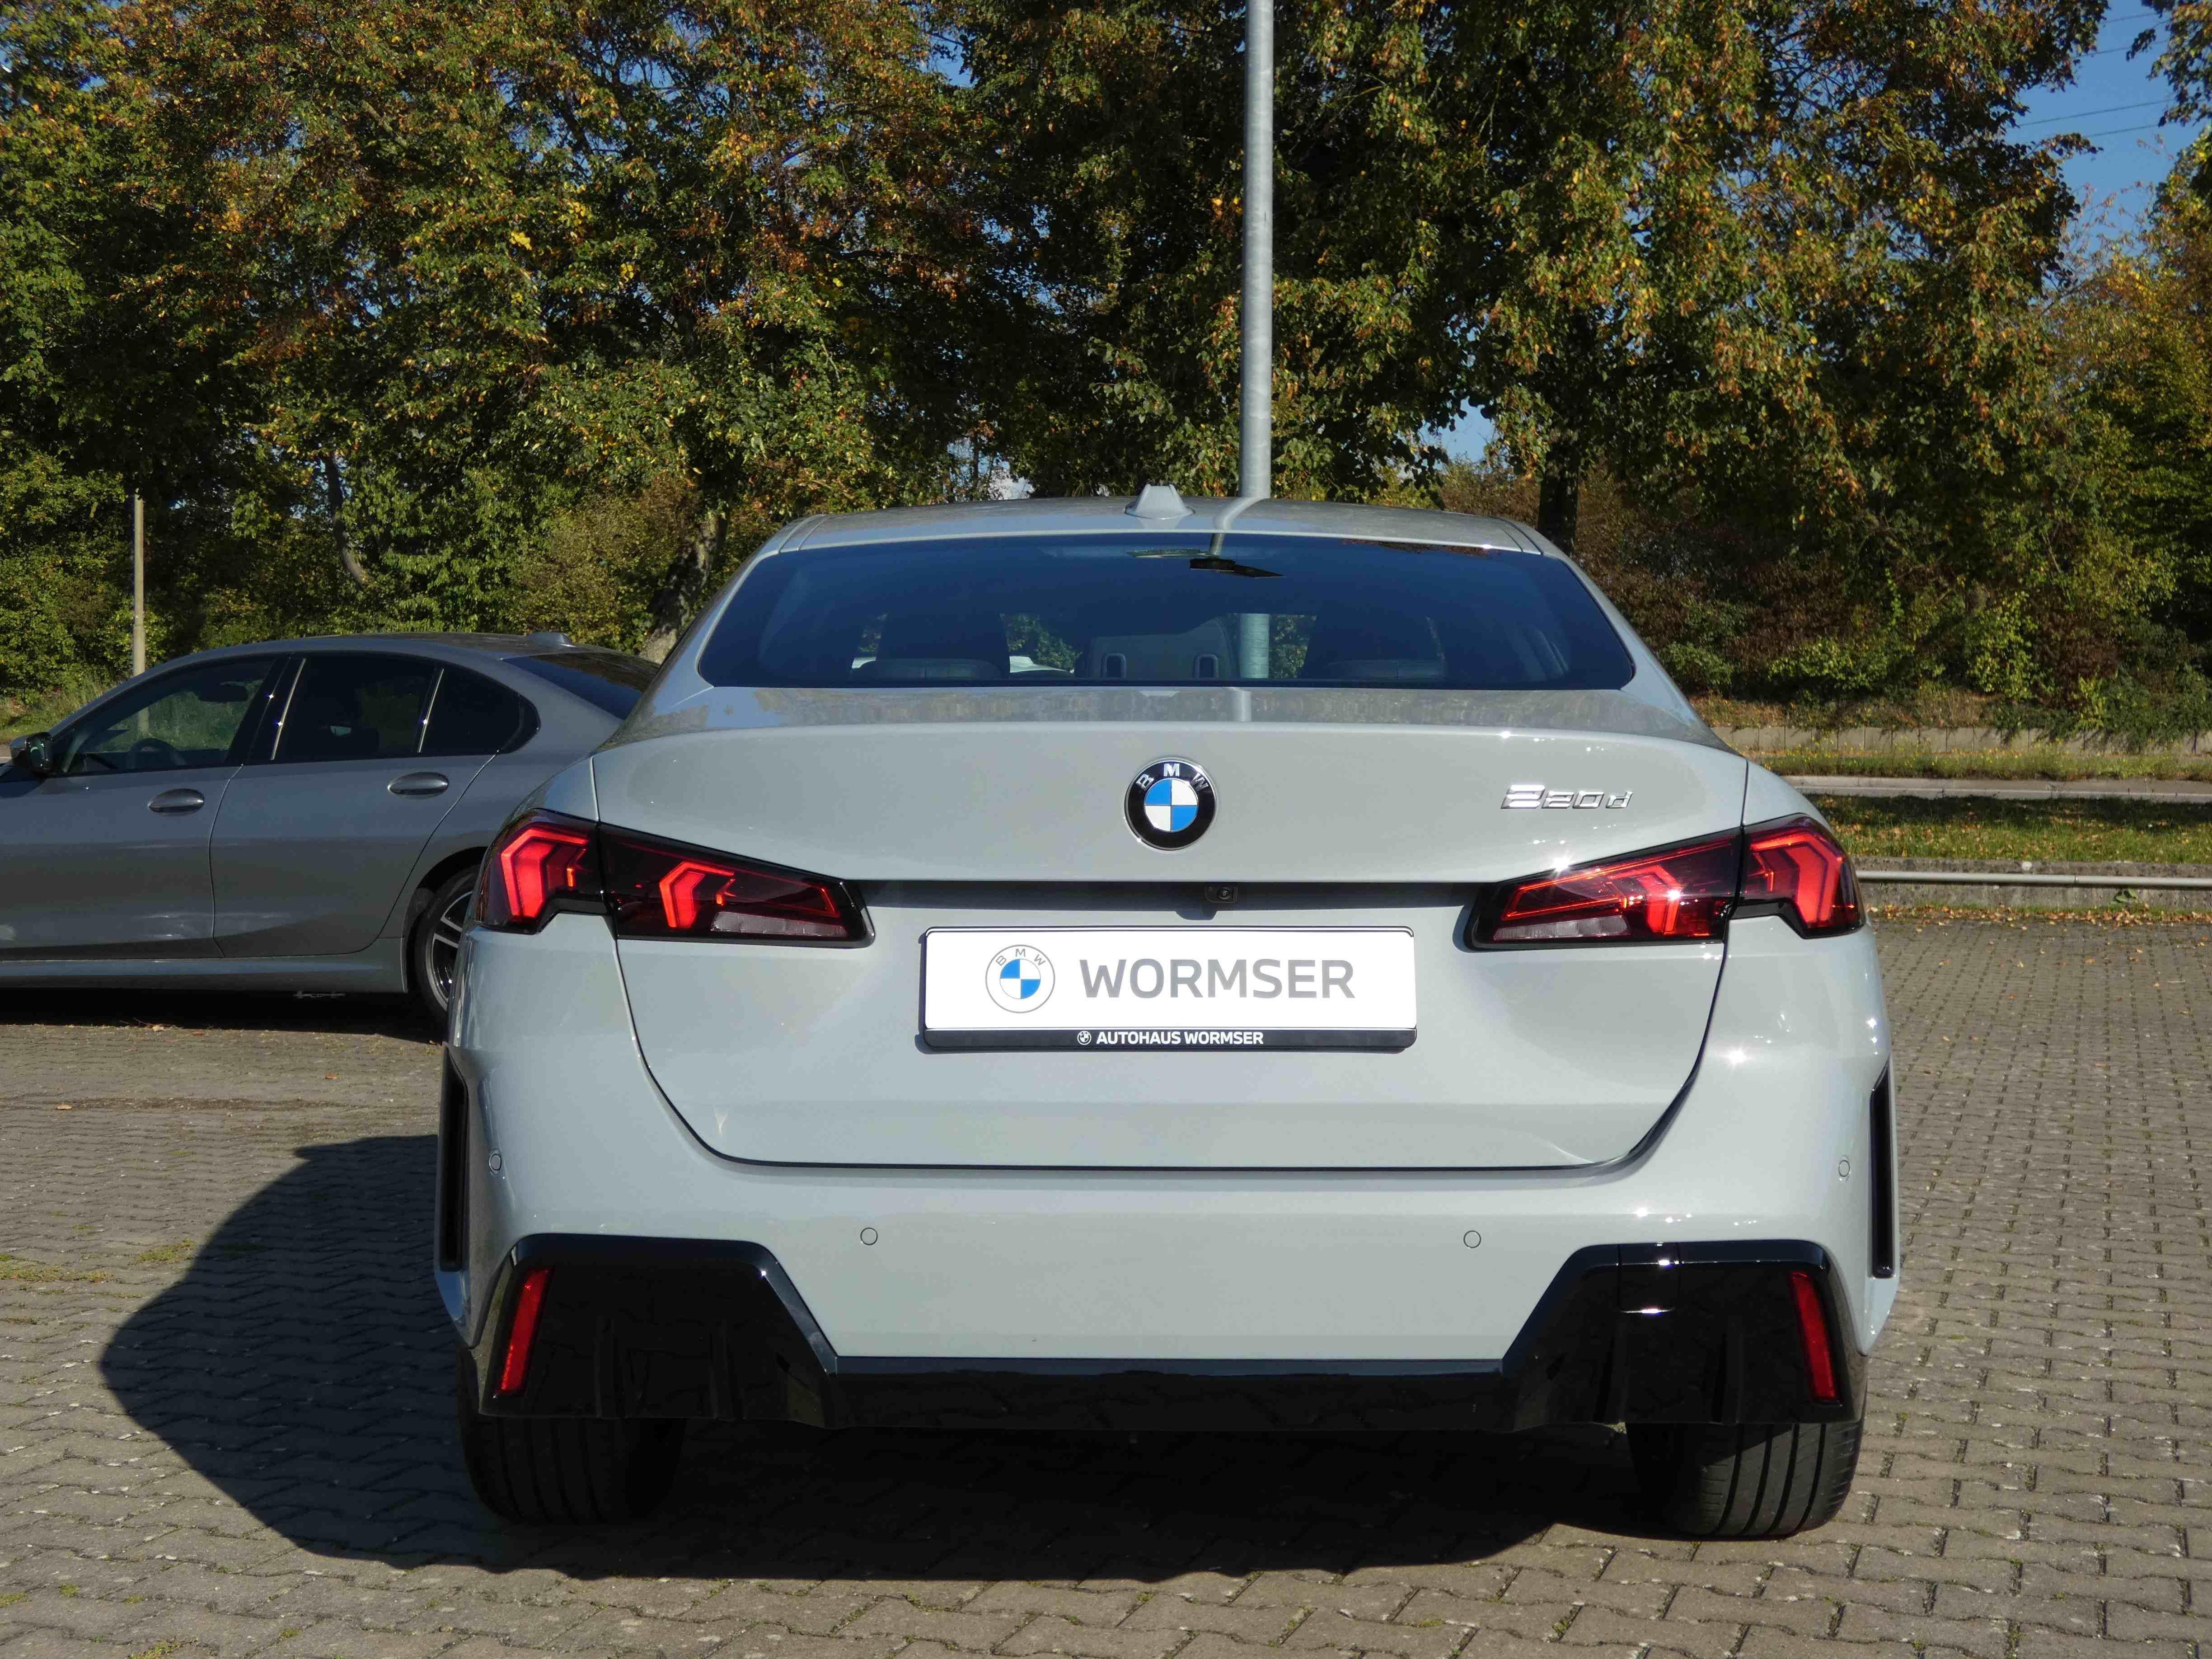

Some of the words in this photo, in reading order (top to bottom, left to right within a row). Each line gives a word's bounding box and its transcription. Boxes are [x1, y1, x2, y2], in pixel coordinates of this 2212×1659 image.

[1136, 764, 1209, 791] BMW
[996, 948, 1046, 966] BMW
[1079, 959, 1355, 998] WORMSER
[1096, 1031, 1181, 1045] AUTOHAUS
[1184, 1031, 1264, 1045] WORMSER
